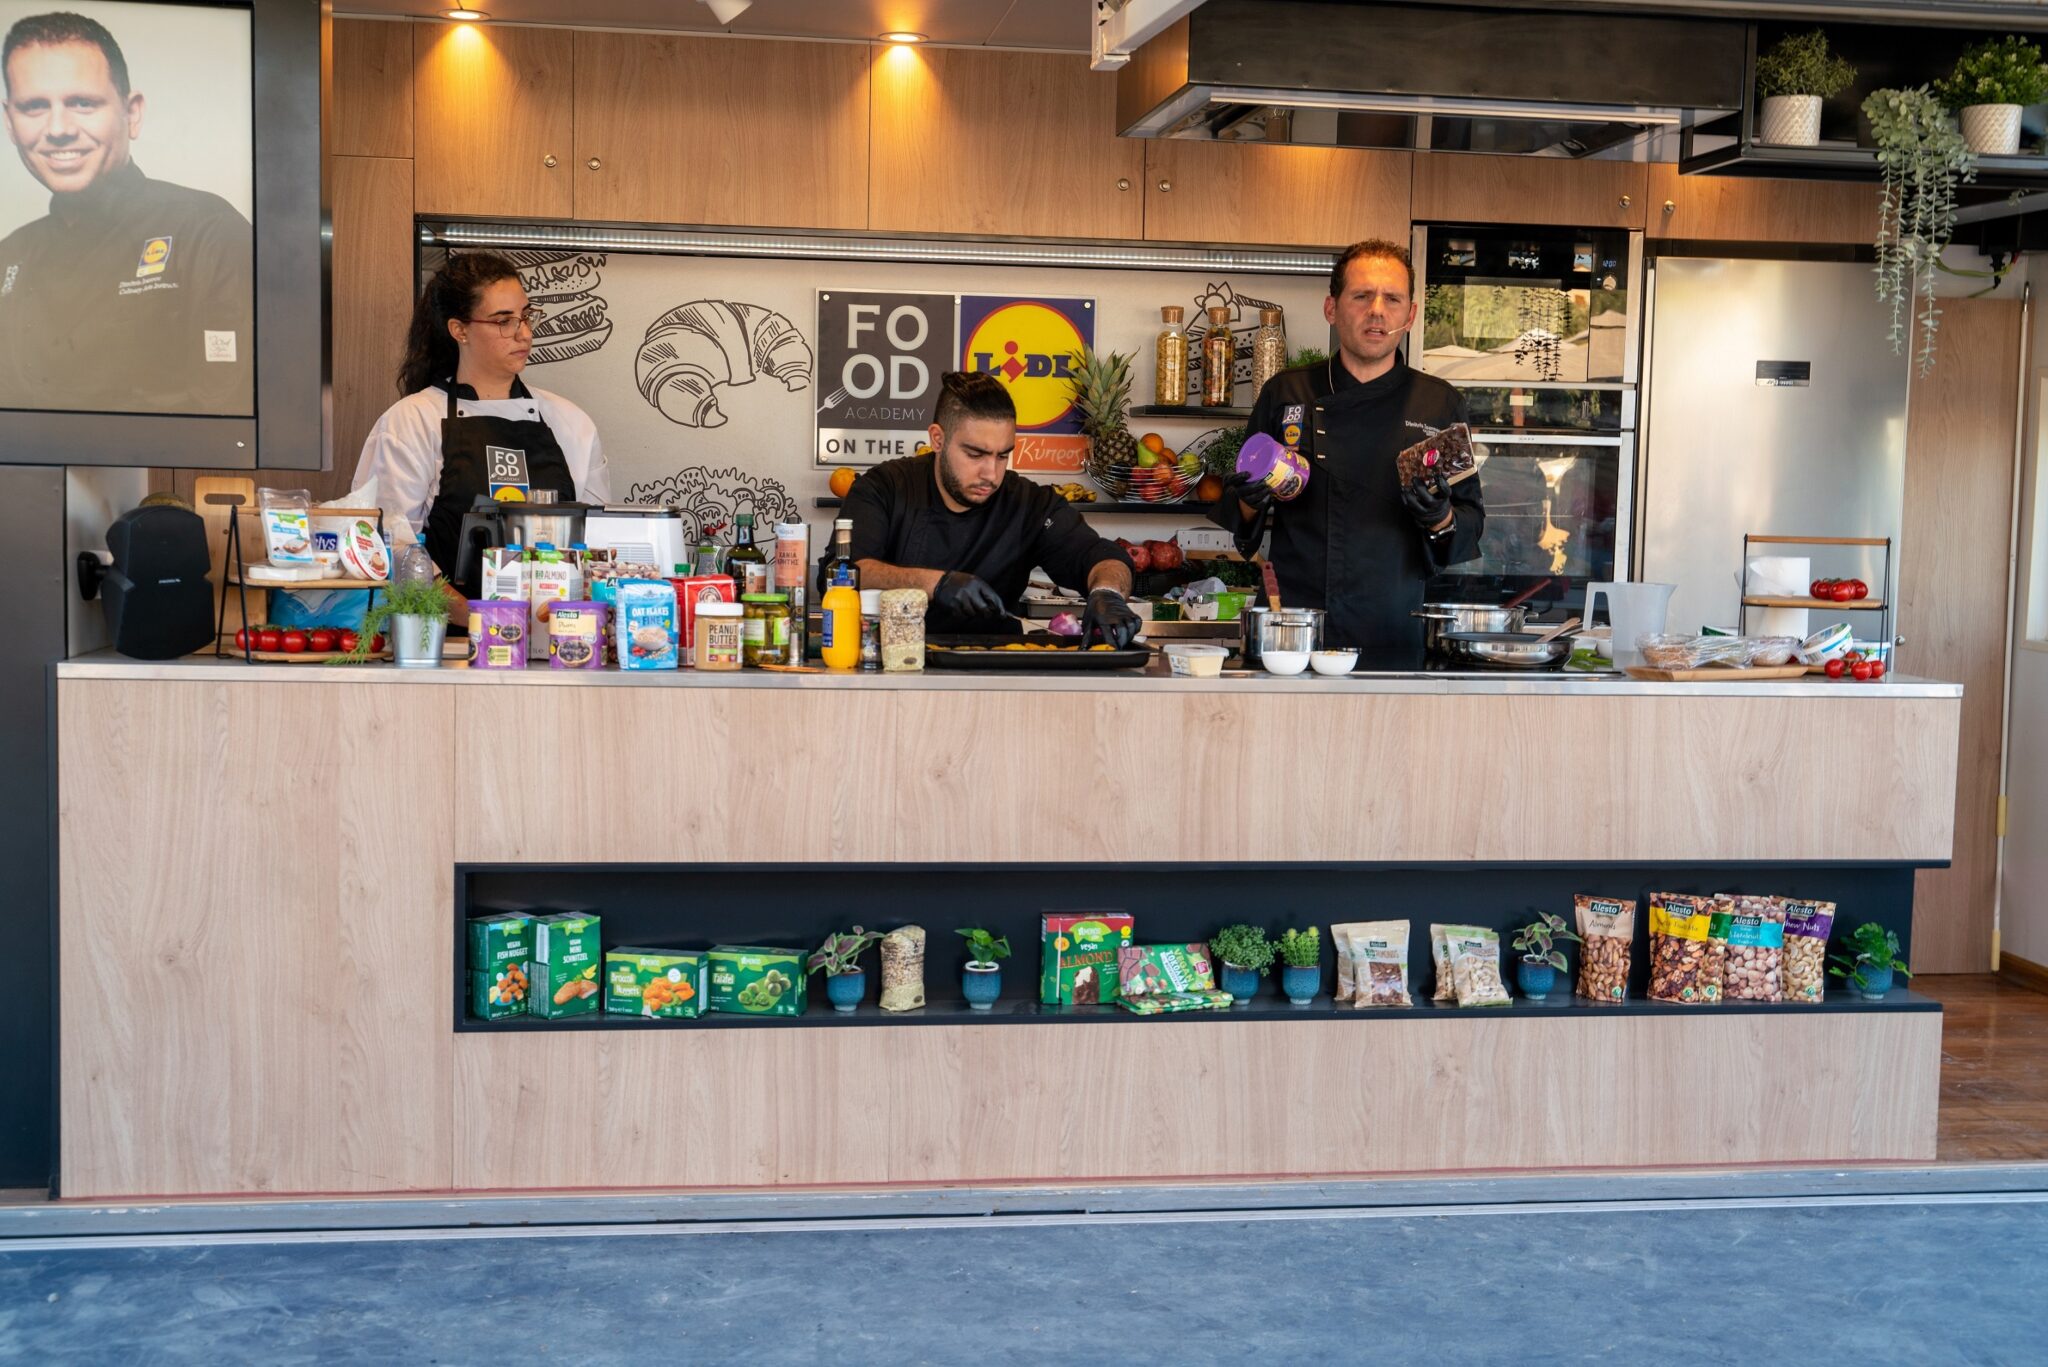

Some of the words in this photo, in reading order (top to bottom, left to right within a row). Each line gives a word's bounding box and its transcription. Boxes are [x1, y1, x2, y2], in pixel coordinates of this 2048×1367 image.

[844, 406, 926, 421] ACADEMY
[826, 438, 856, 454] ON
[865, 439, 905, 455] THE
[1017, 438, 1081, 467] Κύπρος
[632, 607, 644, 616] OAT
[646, 606, 669, 616] FLAKES
[642, 615, 661, 625] FINE
[709, 624, 738, 634] PEANUT
[709, 635, 738, 645] BUTTER
[1592, 903, 1618, 914] Alesto
[1667, 904, 1692, 915] Alesto
[1786, 905, 1813, 915] Alesto
[1732, 916, 1760, 926] Alesto
[1802, 922, 1820, 932] Nuts
[1080, 943, 1098, 951] vegan
[497, 951, 509, 960] FISH
[563, 953, 588, 964] SCHNITZEL
[1059, 951, 1114, 968] ALMOND
[1174, 948, 1194, 983] VEGAN
[611, 972, 636, 983] Broccoli
[713, 973, 734, 984] Falafel
